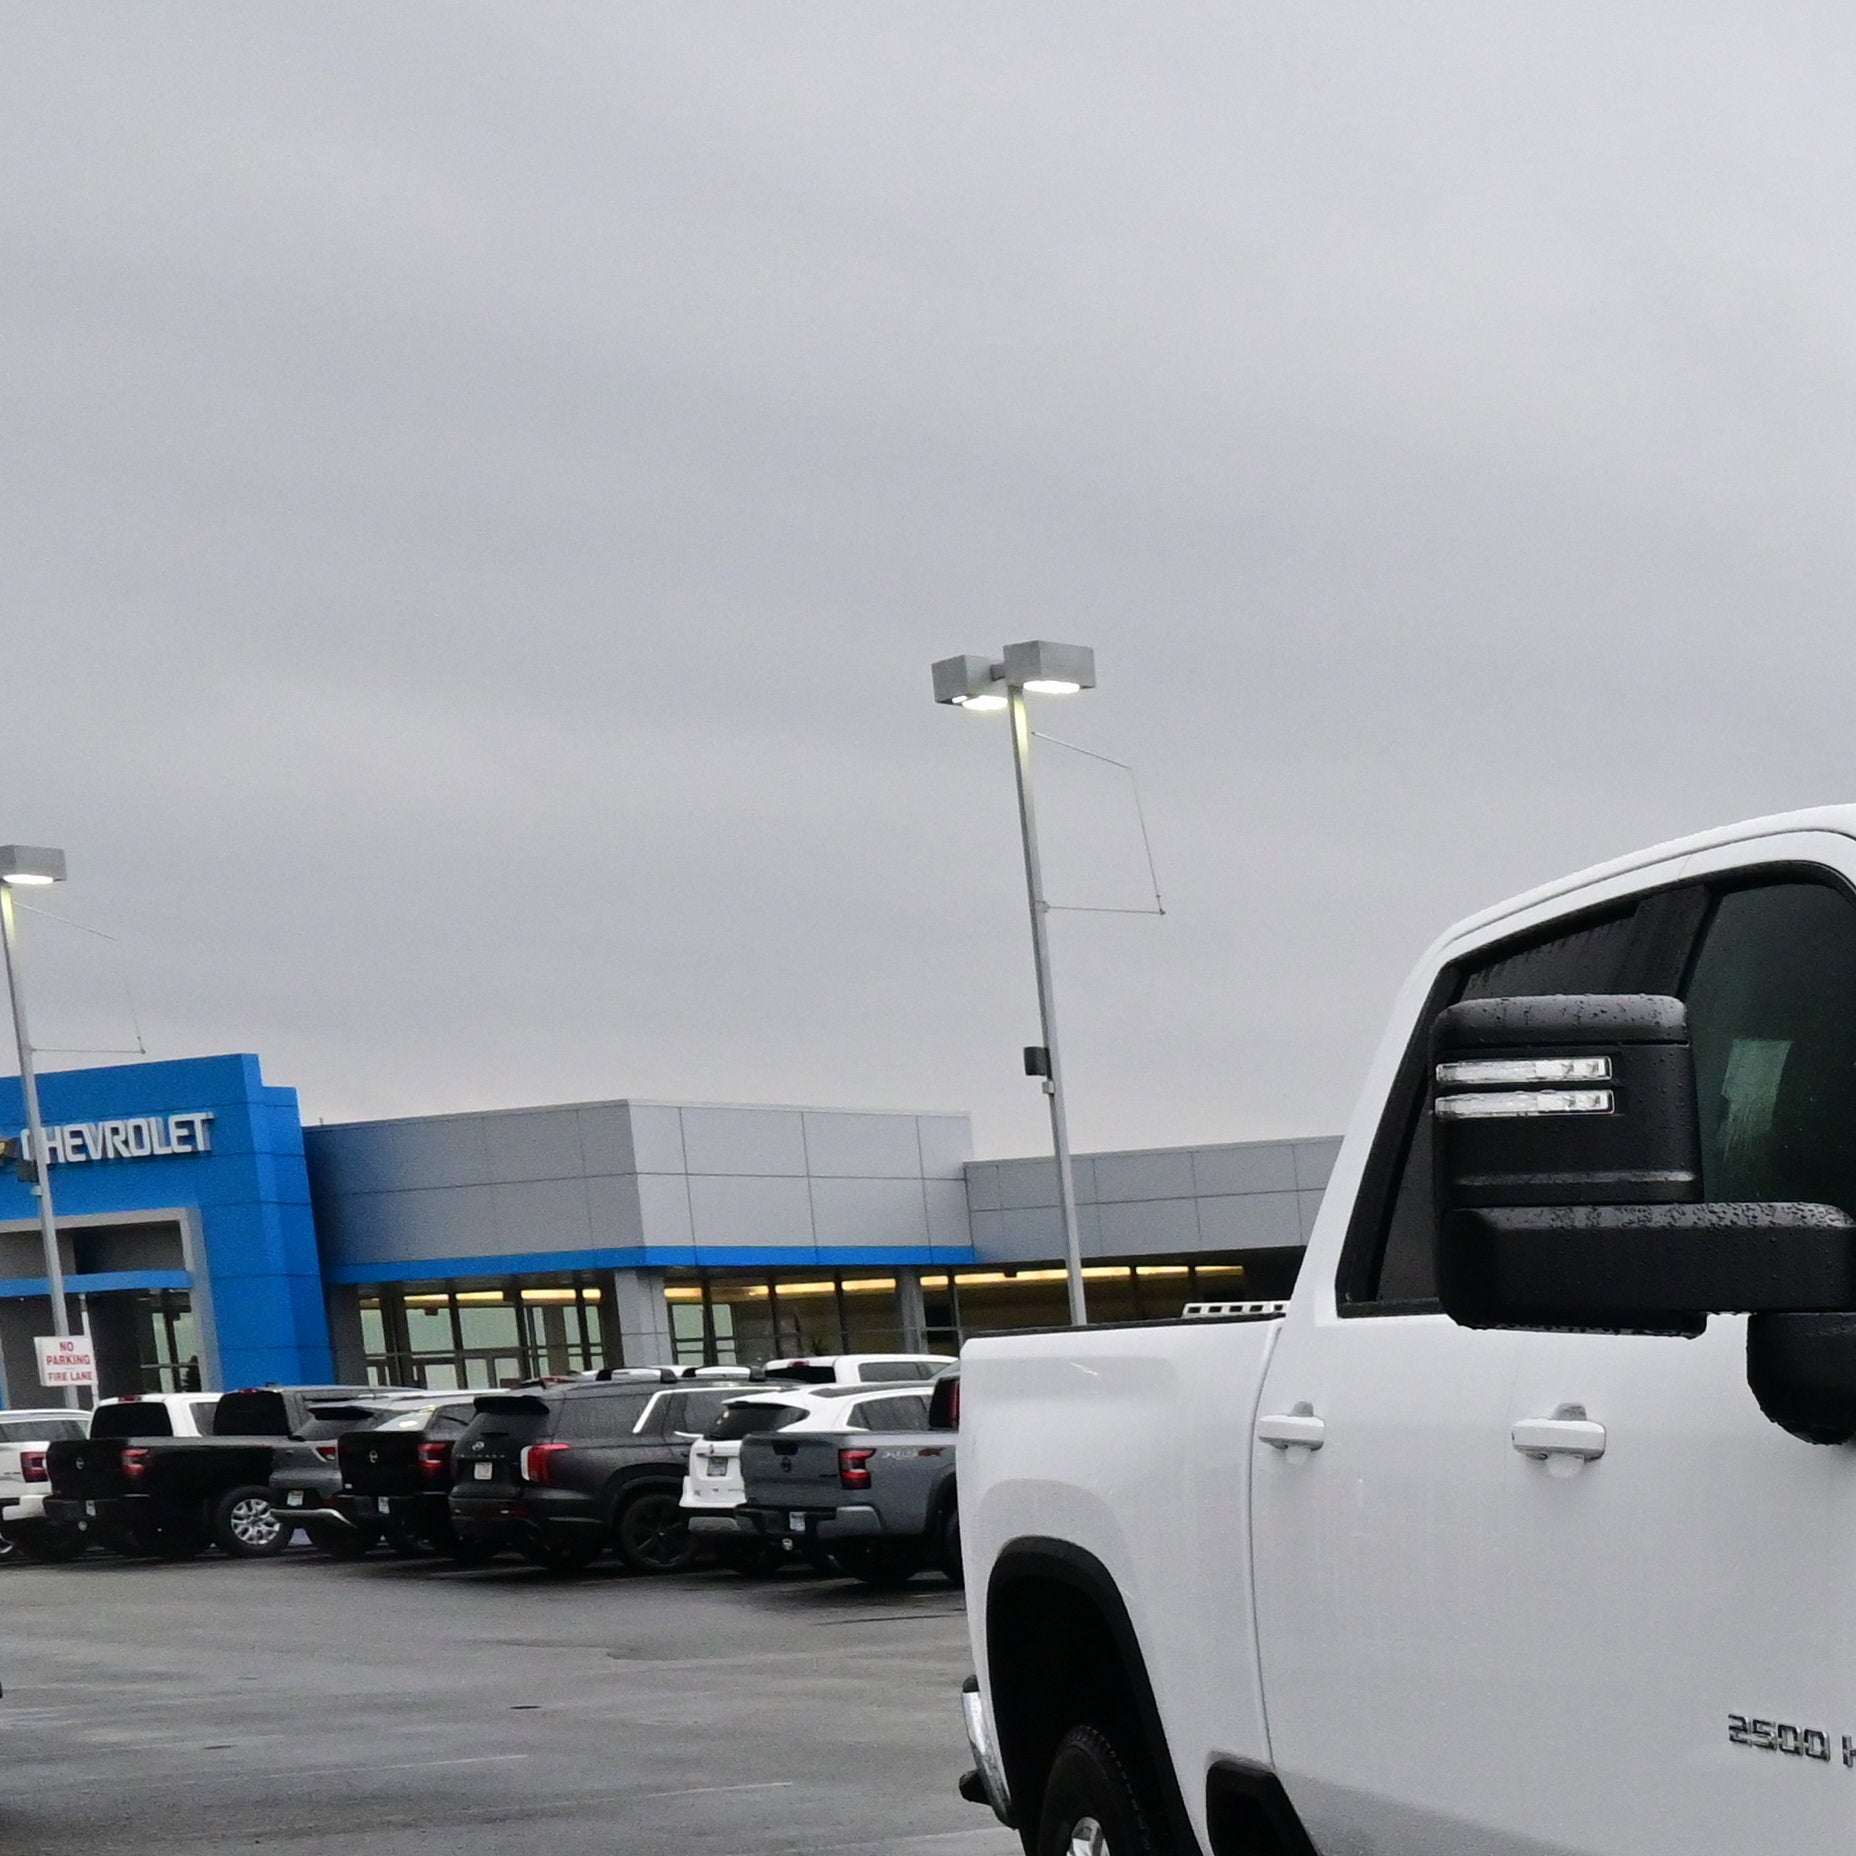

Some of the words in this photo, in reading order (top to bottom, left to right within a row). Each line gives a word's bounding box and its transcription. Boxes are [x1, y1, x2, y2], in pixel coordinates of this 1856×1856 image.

[59, 1341, 74, 1352] NO
[46, 1354, 91, 1365] PARKING
[48, 1372, 67, 1382] FIRE
[70, 1371, 93, 1381] LANE
[1728, 1713, 1831, 1762] 2500
